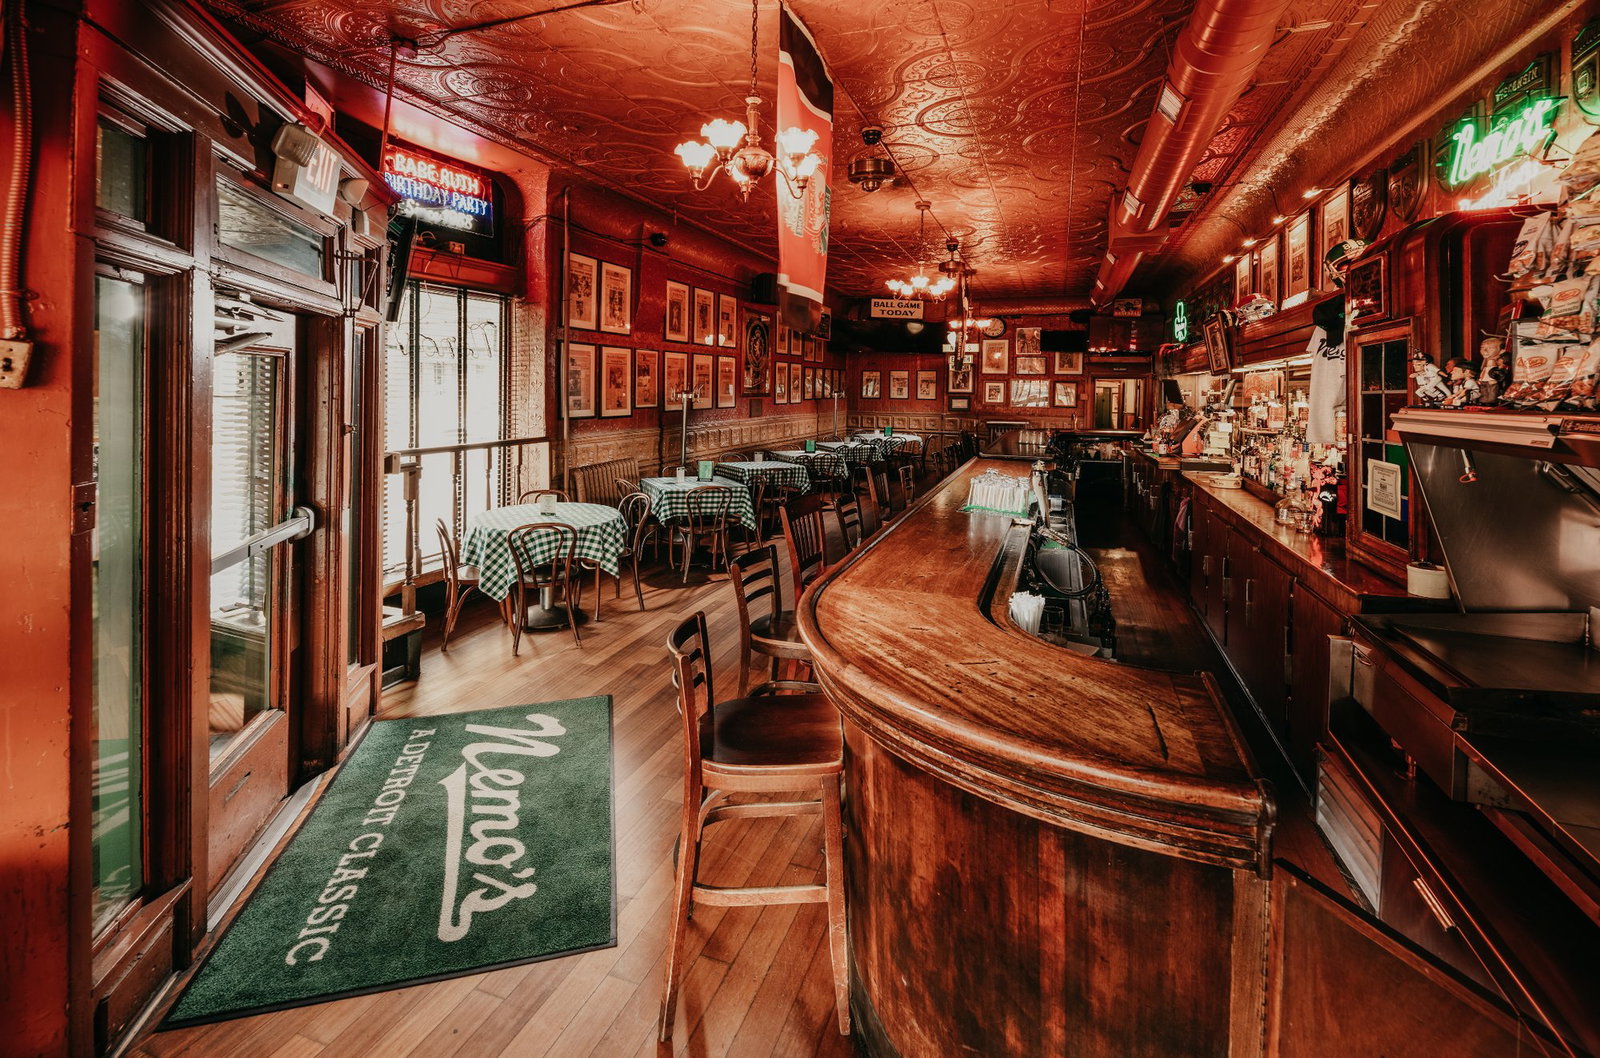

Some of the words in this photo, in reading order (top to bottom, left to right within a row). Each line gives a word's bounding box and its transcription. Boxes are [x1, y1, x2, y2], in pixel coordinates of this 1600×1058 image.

[305, 143, 337, 194] EXIT
[394, 153, 439, 182] BABE
[440, 167, 480, 195] RUTH
[384, 171, 450, 206] BIRTHDAY
[452, 190, 488, 216] PARTY
[898, 302, 921, 310] GAME
[409, 728, 437, 740] A
[363, 741, 430, 826] DETROIT
[437, 713, 567, 942] Nemo's
[285, 832, 384, 966] CLASSIC
